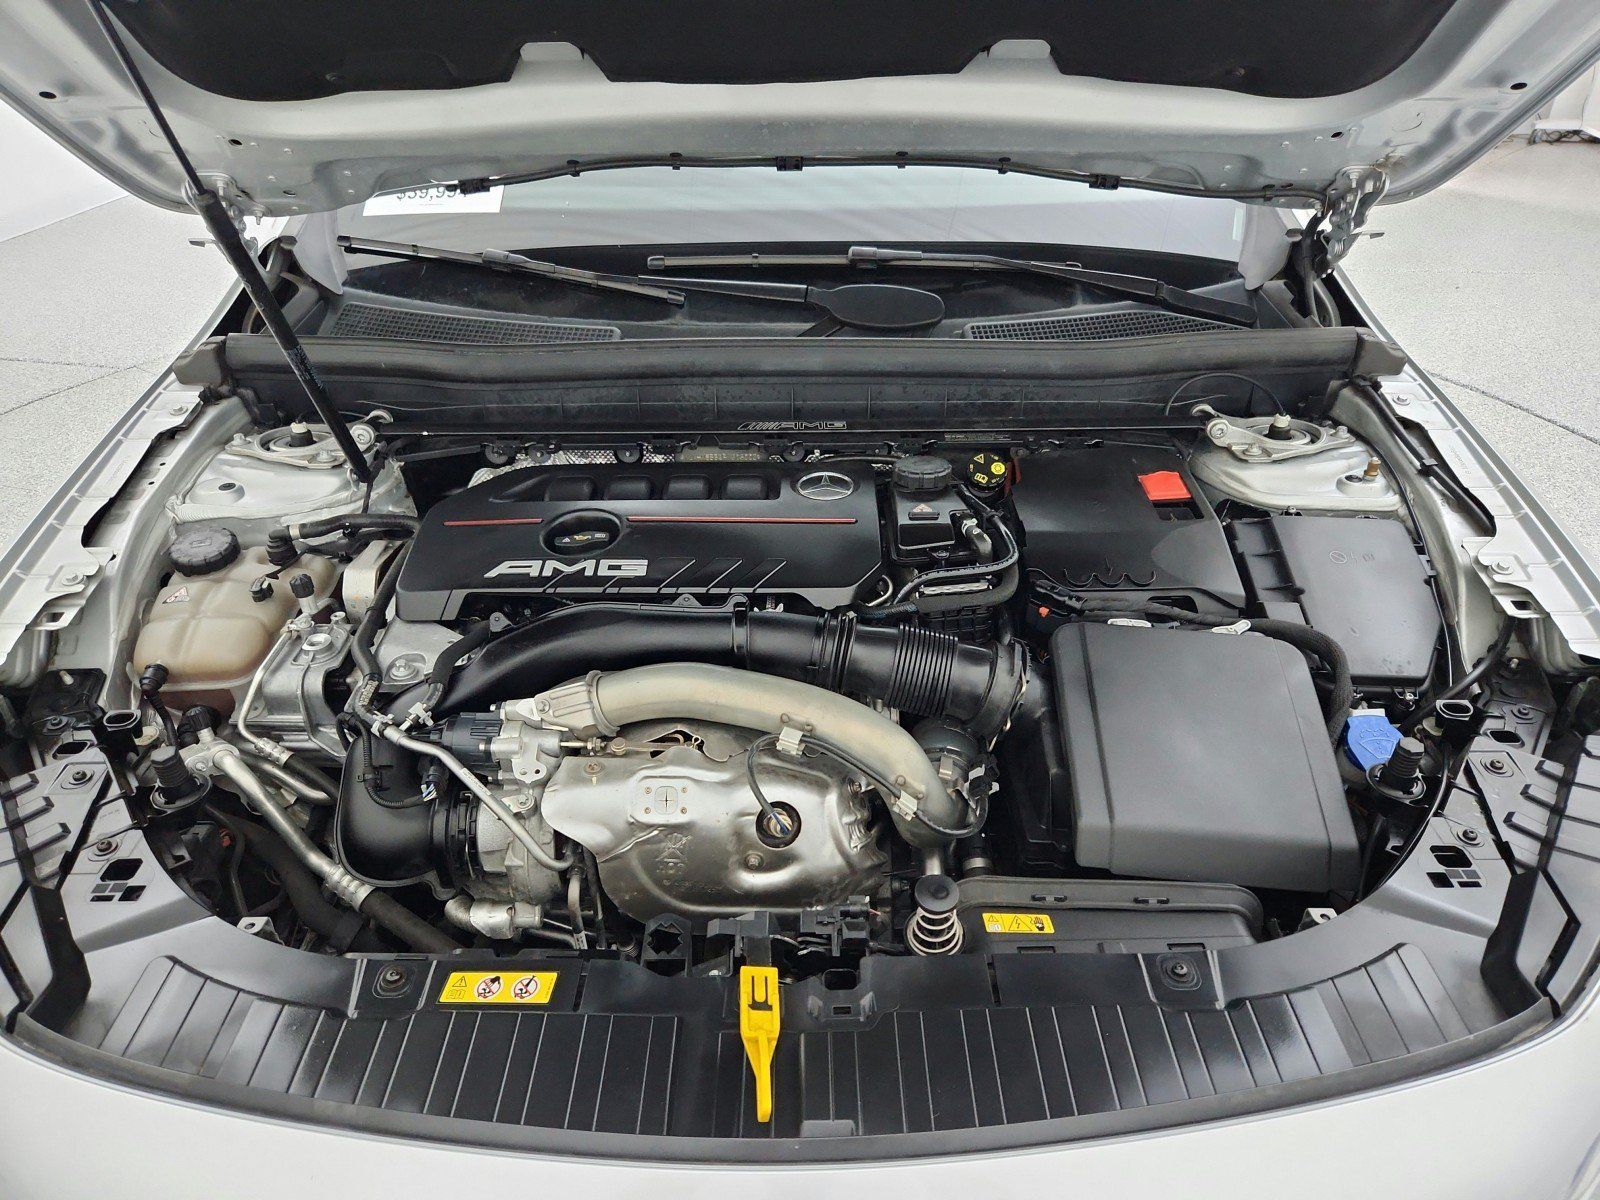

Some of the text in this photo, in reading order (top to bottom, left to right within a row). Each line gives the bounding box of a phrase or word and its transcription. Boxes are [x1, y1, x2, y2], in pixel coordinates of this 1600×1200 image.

[396, 187, 467, 201] $39,99
[777, 421, 847, 430] AMG
[484, 559, 648, 578] AMG
